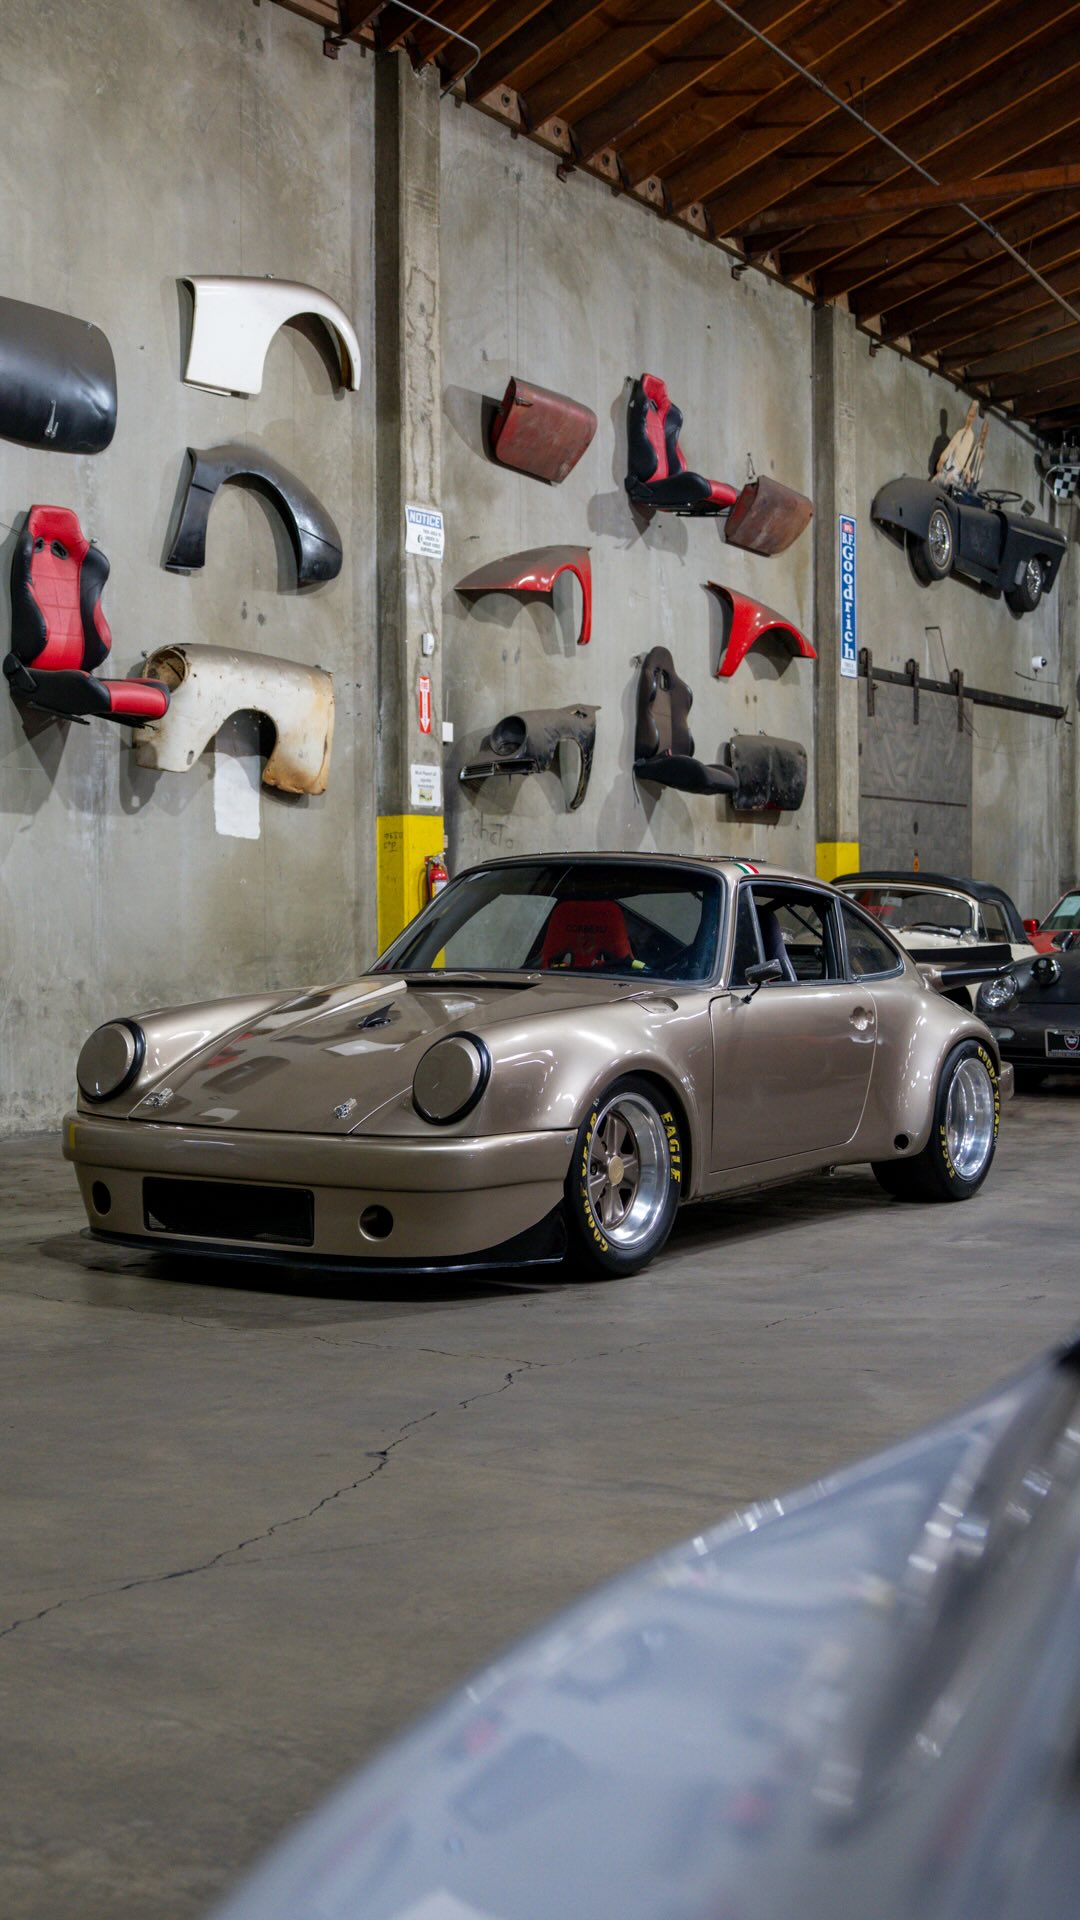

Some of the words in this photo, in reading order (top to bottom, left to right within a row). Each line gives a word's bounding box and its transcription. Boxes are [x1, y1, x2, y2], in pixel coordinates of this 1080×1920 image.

[409, 510, 441, 528] NOTICE
[842, 545, 855, 659] Goodrich
[661, 1111, 681, 1183] EAGLE
[940, 1124, 956, 1179] EAGLE
